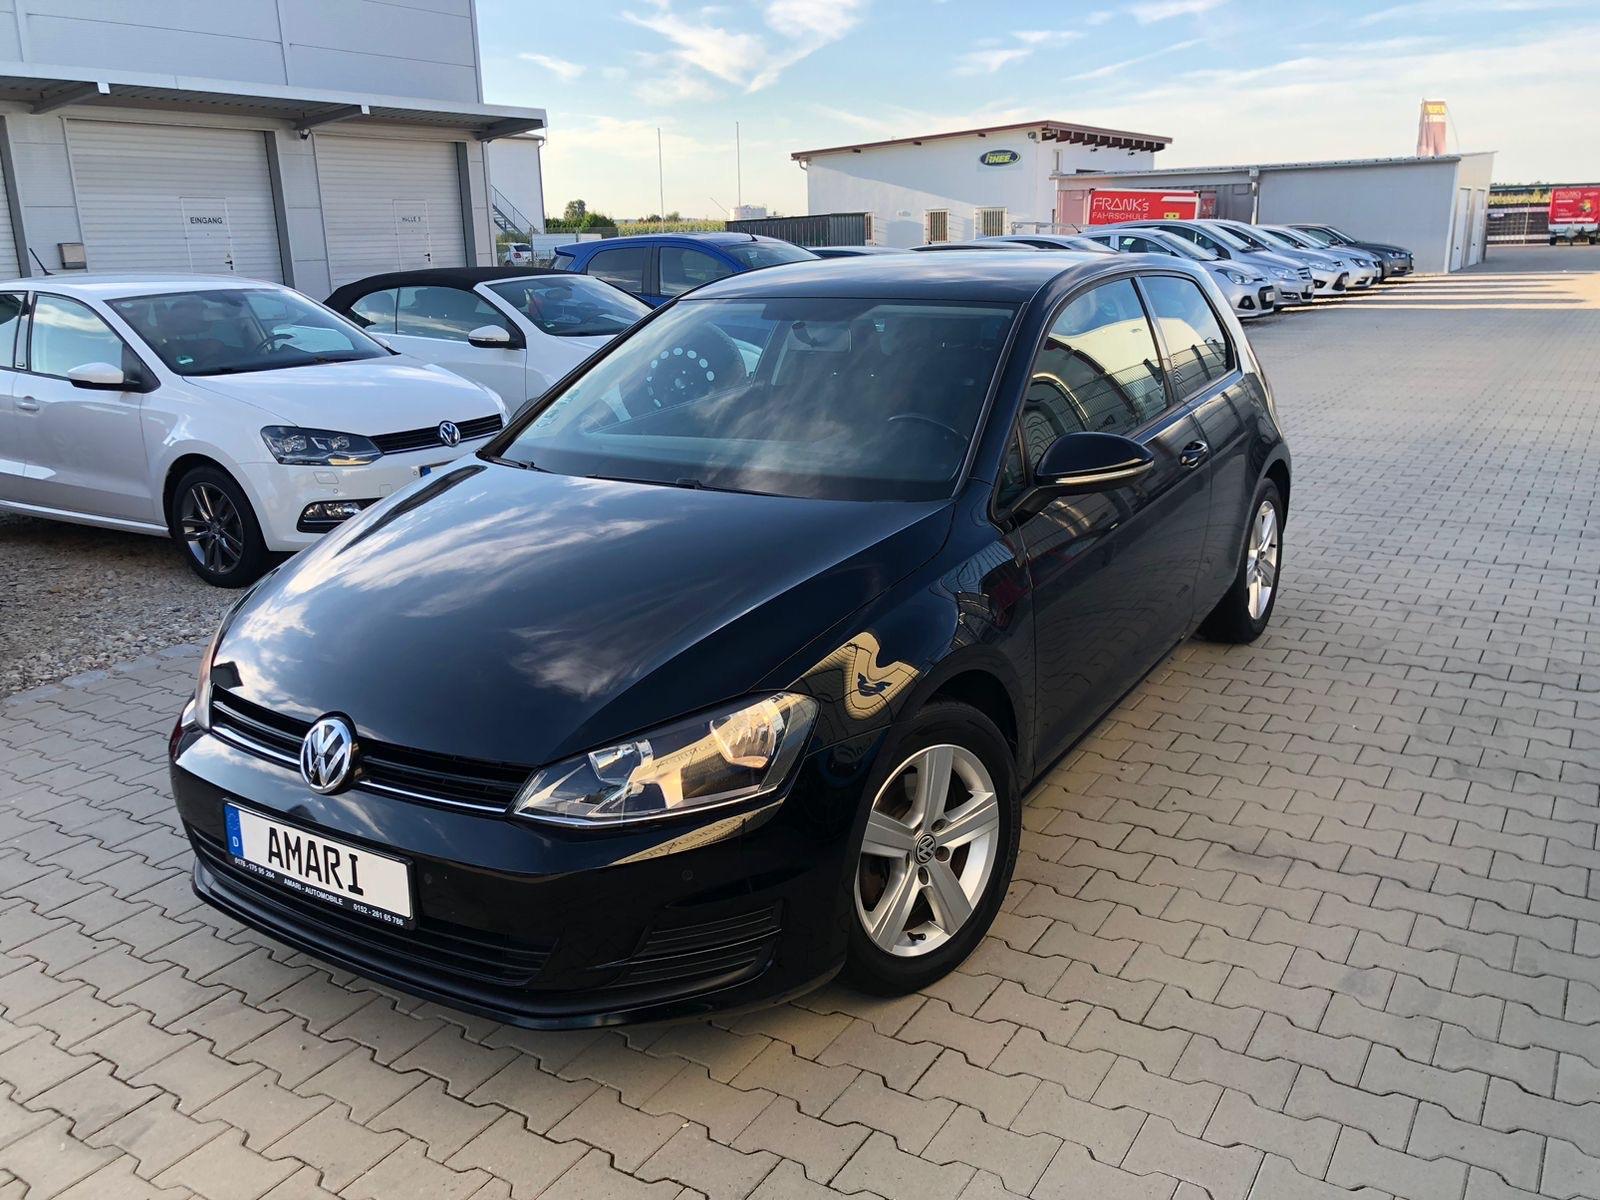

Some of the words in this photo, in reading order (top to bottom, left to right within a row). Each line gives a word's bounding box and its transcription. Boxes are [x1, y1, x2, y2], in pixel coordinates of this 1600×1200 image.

[190, 216, 223, 224] EINGANG
[1092, 212, 1149, 220] FAHRSCHULE
[232, 836, 240, 847] D
[268, 827, 364, 896] AMARI
[284, 878, 302, 890] AMARI
[305, 886, 343, 905] AUTOMOBILE
[353, 903, 368, 914] 0152
